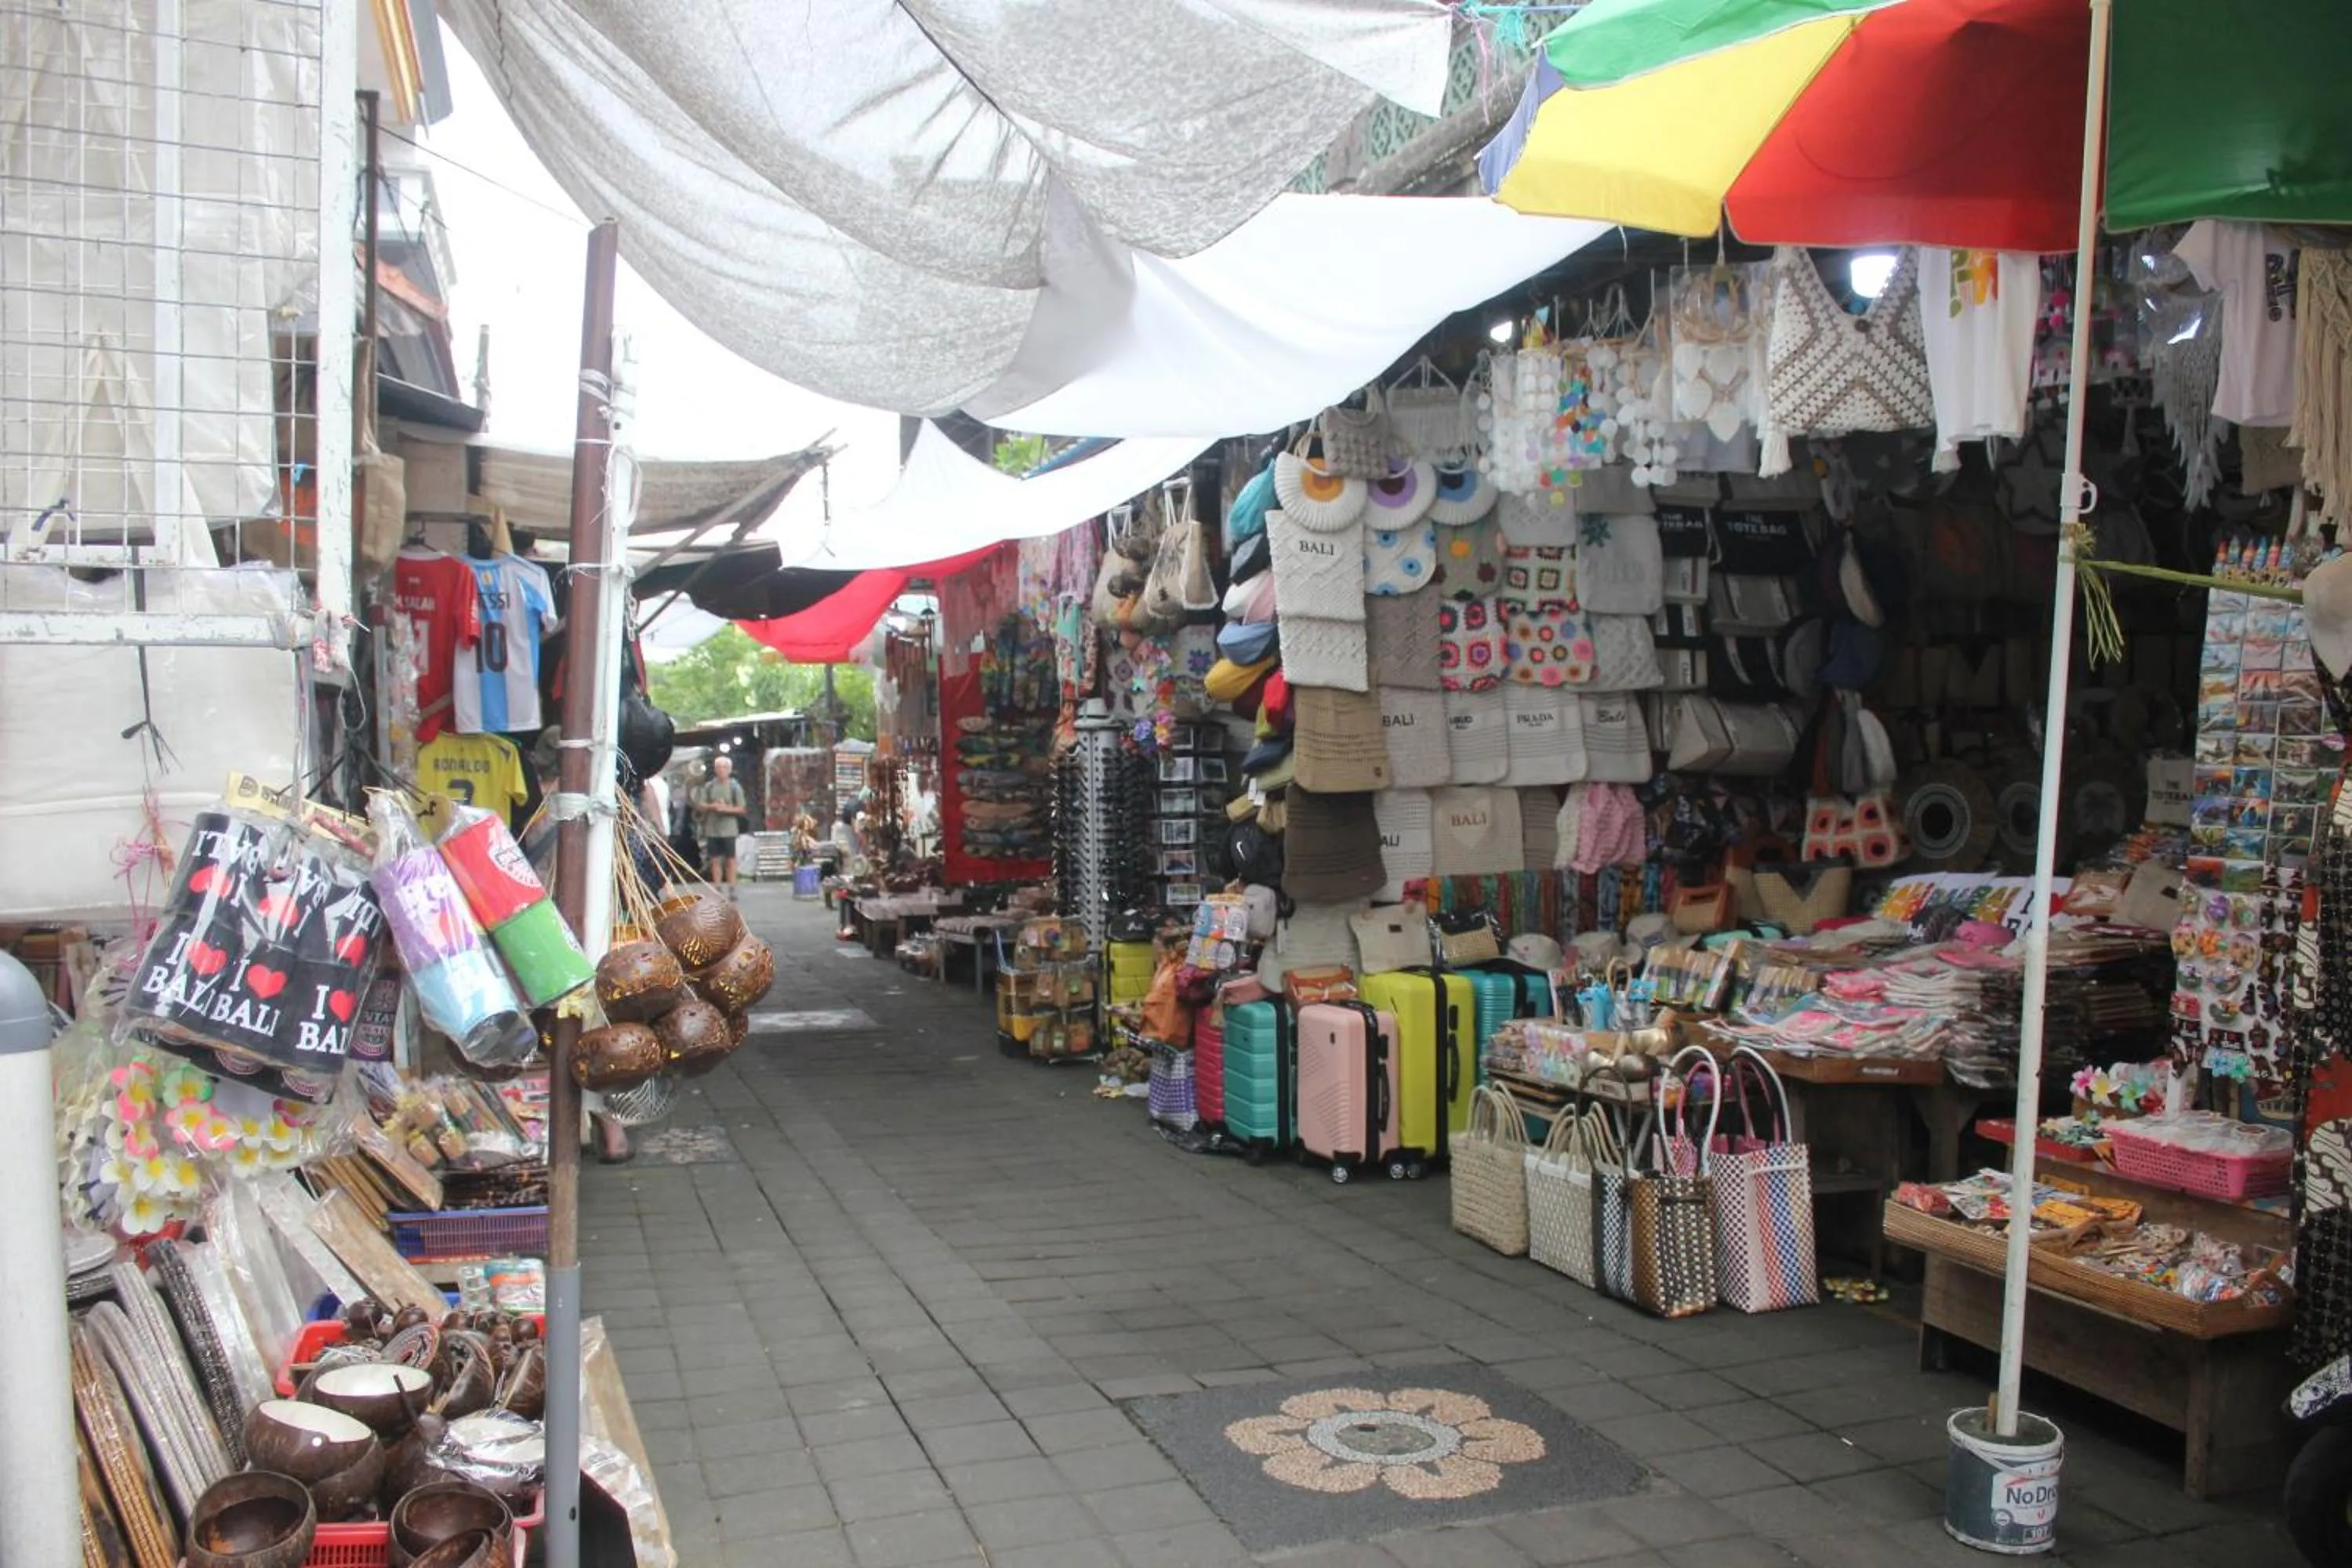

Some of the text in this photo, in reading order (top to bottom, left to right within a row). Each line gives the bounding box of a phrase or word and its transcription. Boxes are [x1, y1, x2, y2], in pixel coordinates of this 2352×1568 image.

[1299, 540, 1335, 556] BALI
[477, 592, 511, 609] ESSI
[1382, 713, 1415, 728] BALI
[434, 757, 490, 774] RONALDO
[1451, 812, 1487, 827] BALI
[1381, 834, 1400, 848] ALI
[228, 959, 252, 993] I
[311, 985, 330, 1020] I
